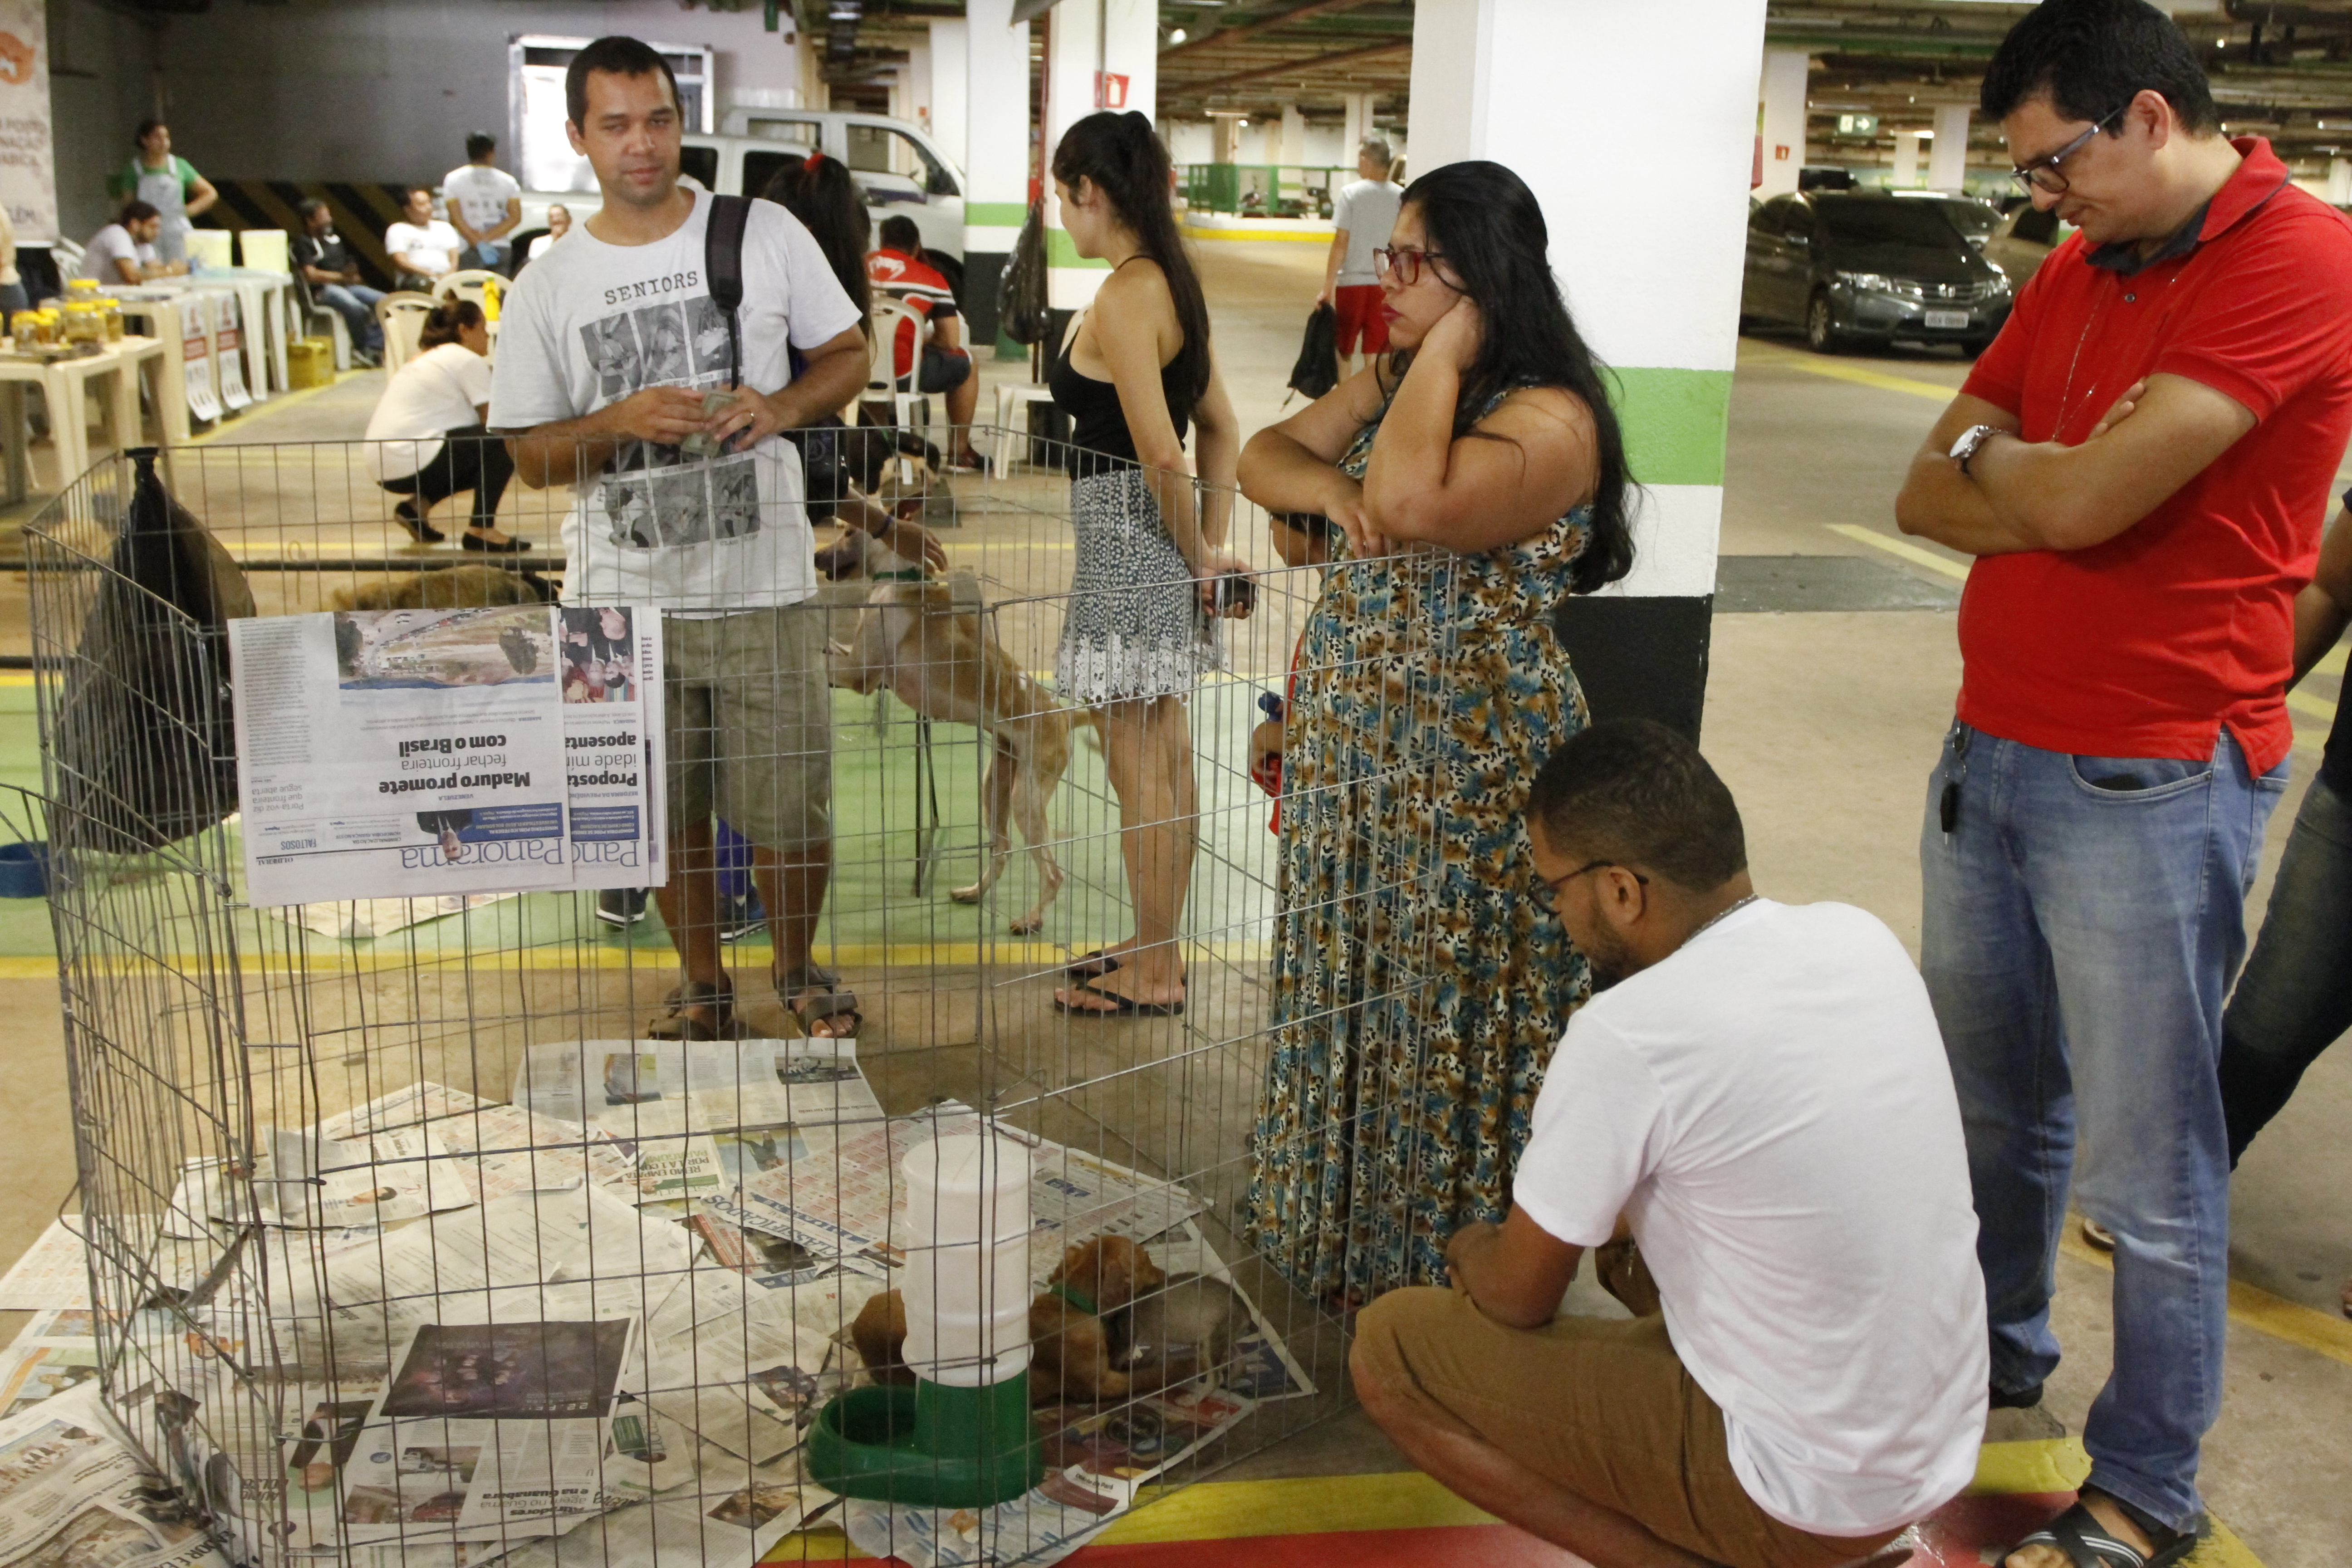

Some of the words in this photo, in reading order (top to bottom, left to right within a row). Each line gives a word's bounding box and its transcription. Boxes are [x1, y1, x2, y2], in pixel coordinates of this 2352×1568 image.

[604, 271, 699, 305] SENIORS
[455, 738, 466, 750] o
[469, 735, 506, 750] com
[565, 731, 636, 750] aposenta
[399, 738, 451, 758] Brasil
[401, 756, 460, 772] fronteira
[464, 754, 506, 768] fechar
[595, 754, 636, 769] idade
[378, 772, 457, 795] promete
[460, 772, 530, 790] Maduro
[252, 787, 277, 795] aberta
[279, 784, 302, 793] segue
[252, 795, 286, 804] fronteira
[266, 803, 304, 811] Porta-voz
[280, 838, 317, 850] FALTOSOS
[399, 838, 564, 869] Panorama
[256, 857, 288, 866] LIBERAL
[687, 1157, 709, 1166] POR
[625, 1168, 667, 1179] EMPATA
[669, 1165, 701, 1176] REMO
[703, 1195, 839, 1257] CLASSIFICADOS
[530, 1499, 547, 1508] no
